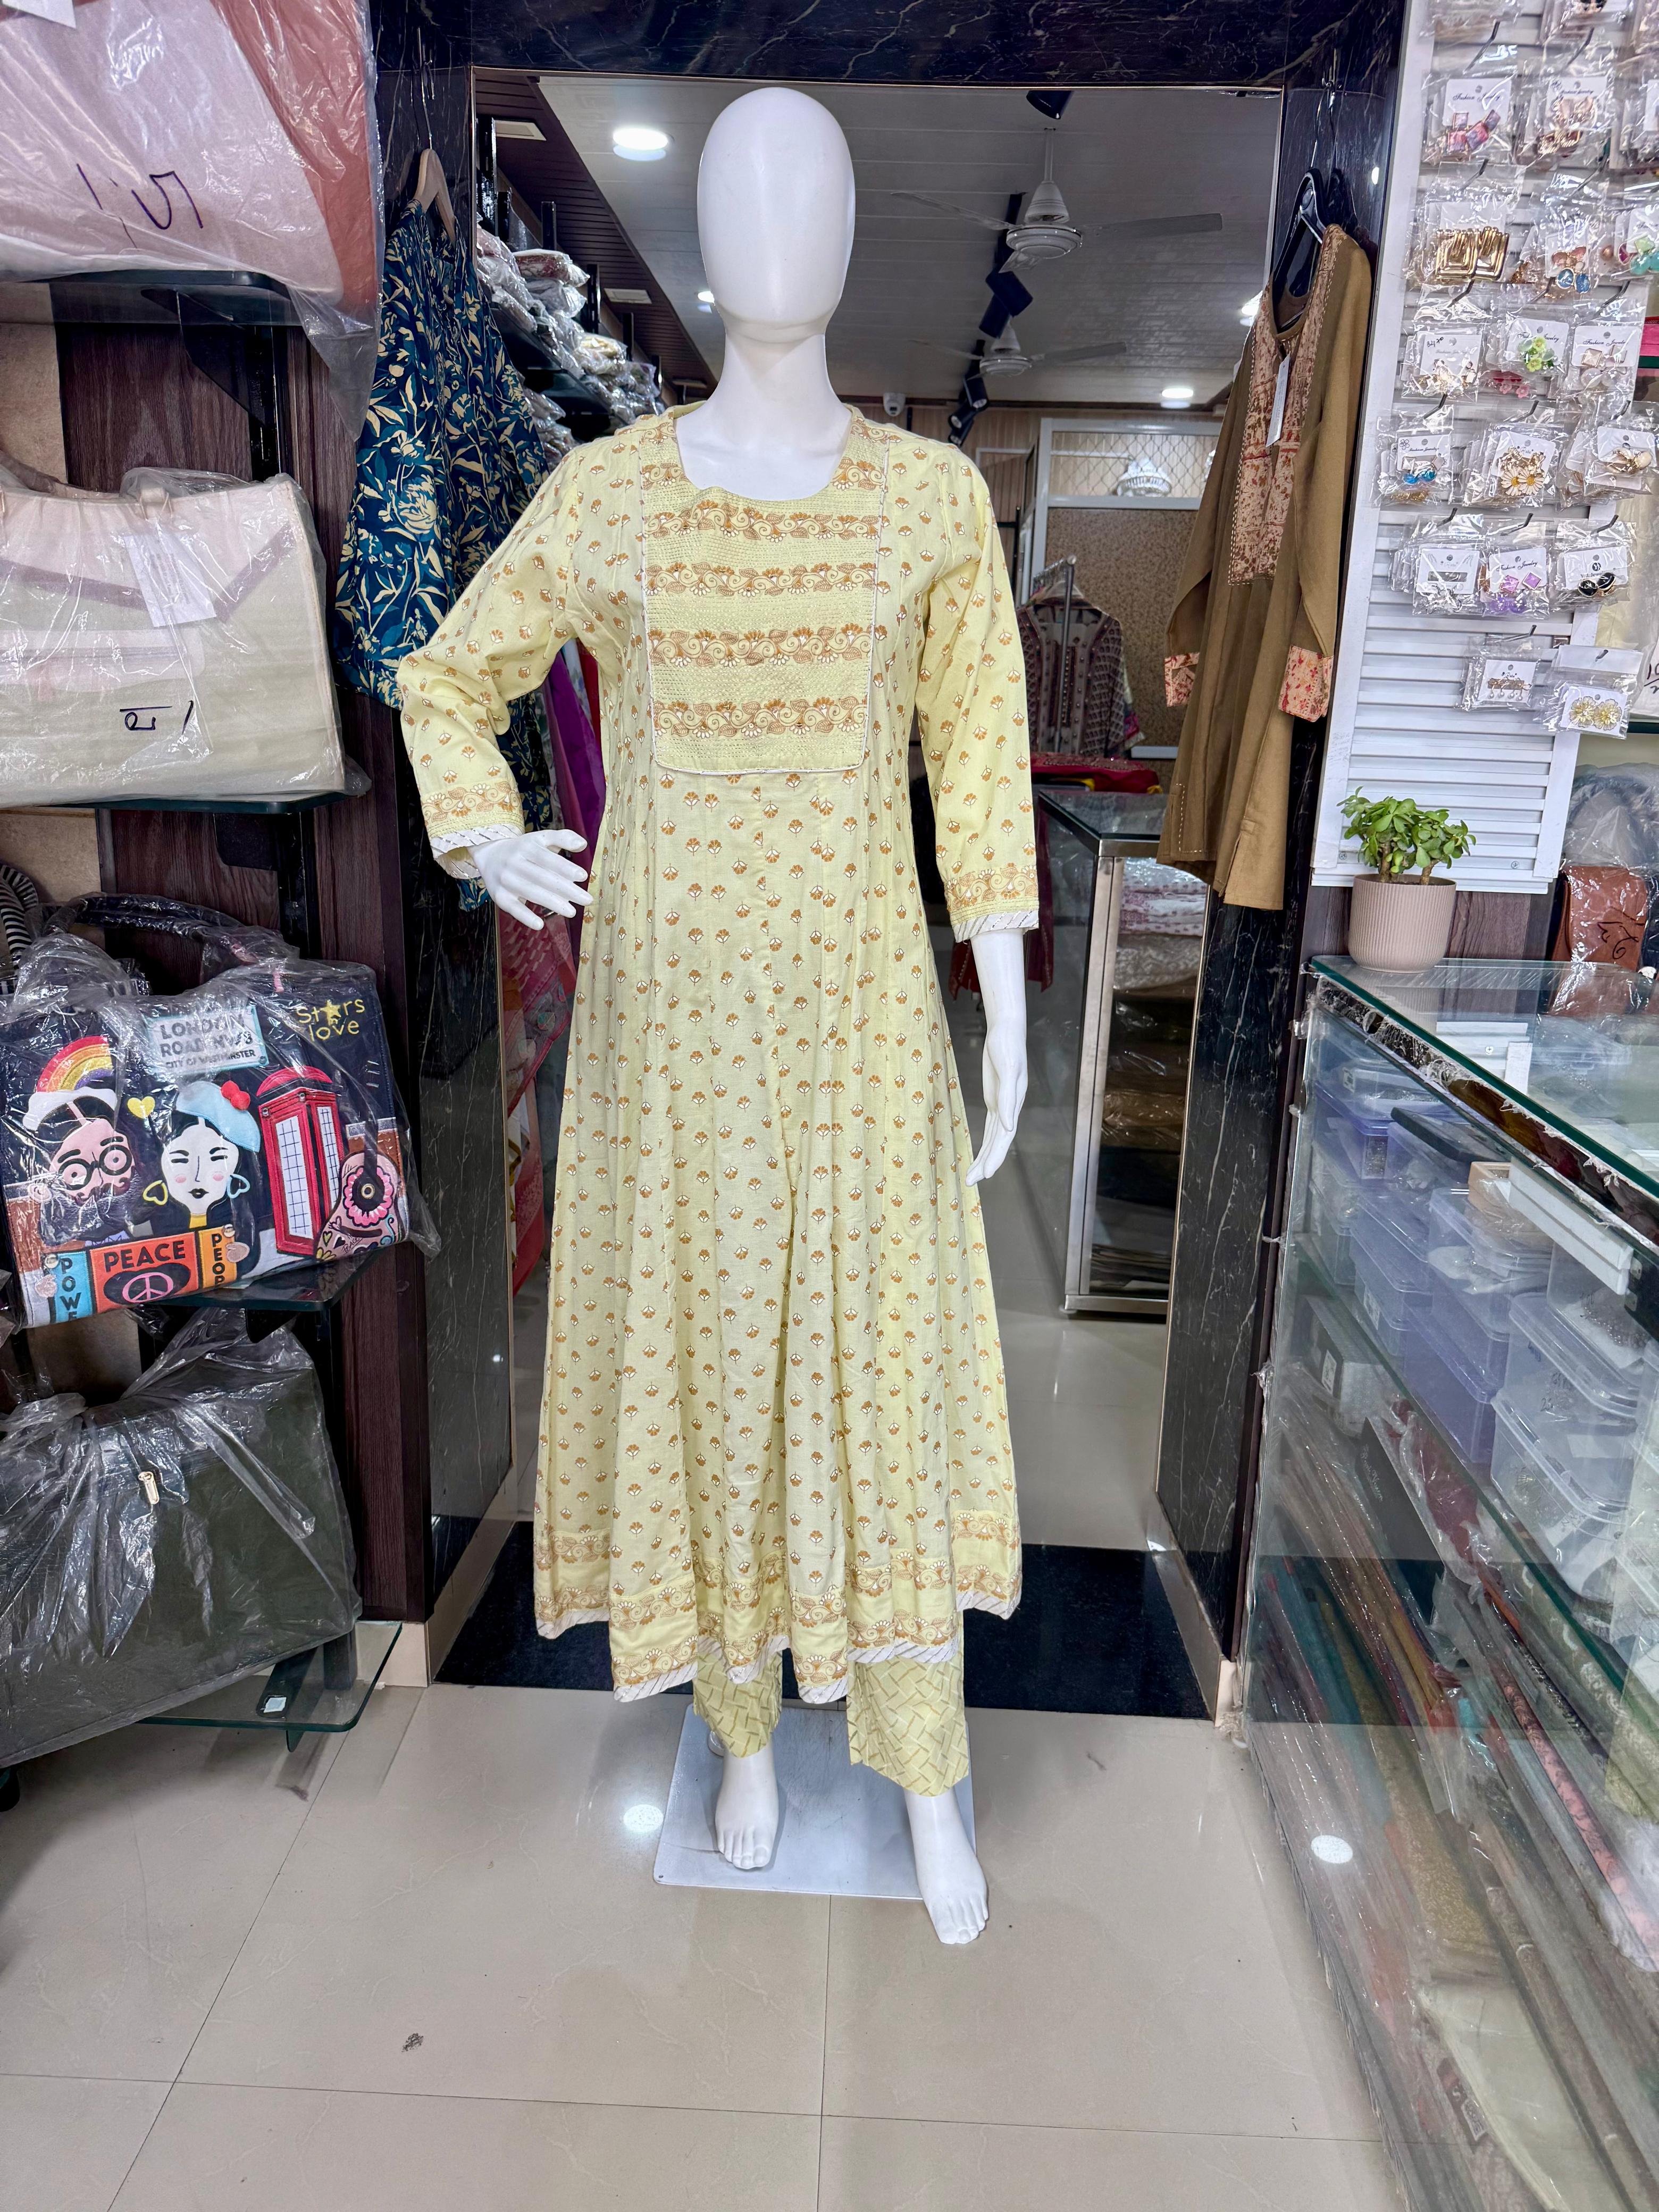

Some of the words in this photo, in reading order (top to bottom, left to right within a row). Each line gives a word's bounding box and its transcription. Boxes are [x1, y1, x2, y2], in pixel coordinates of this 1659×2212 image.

[308, 1020, 359, 1042] love
[199, 1049, 256, 1063] WESTINSTER
[103, 1240, 186, 1272] PEACE
